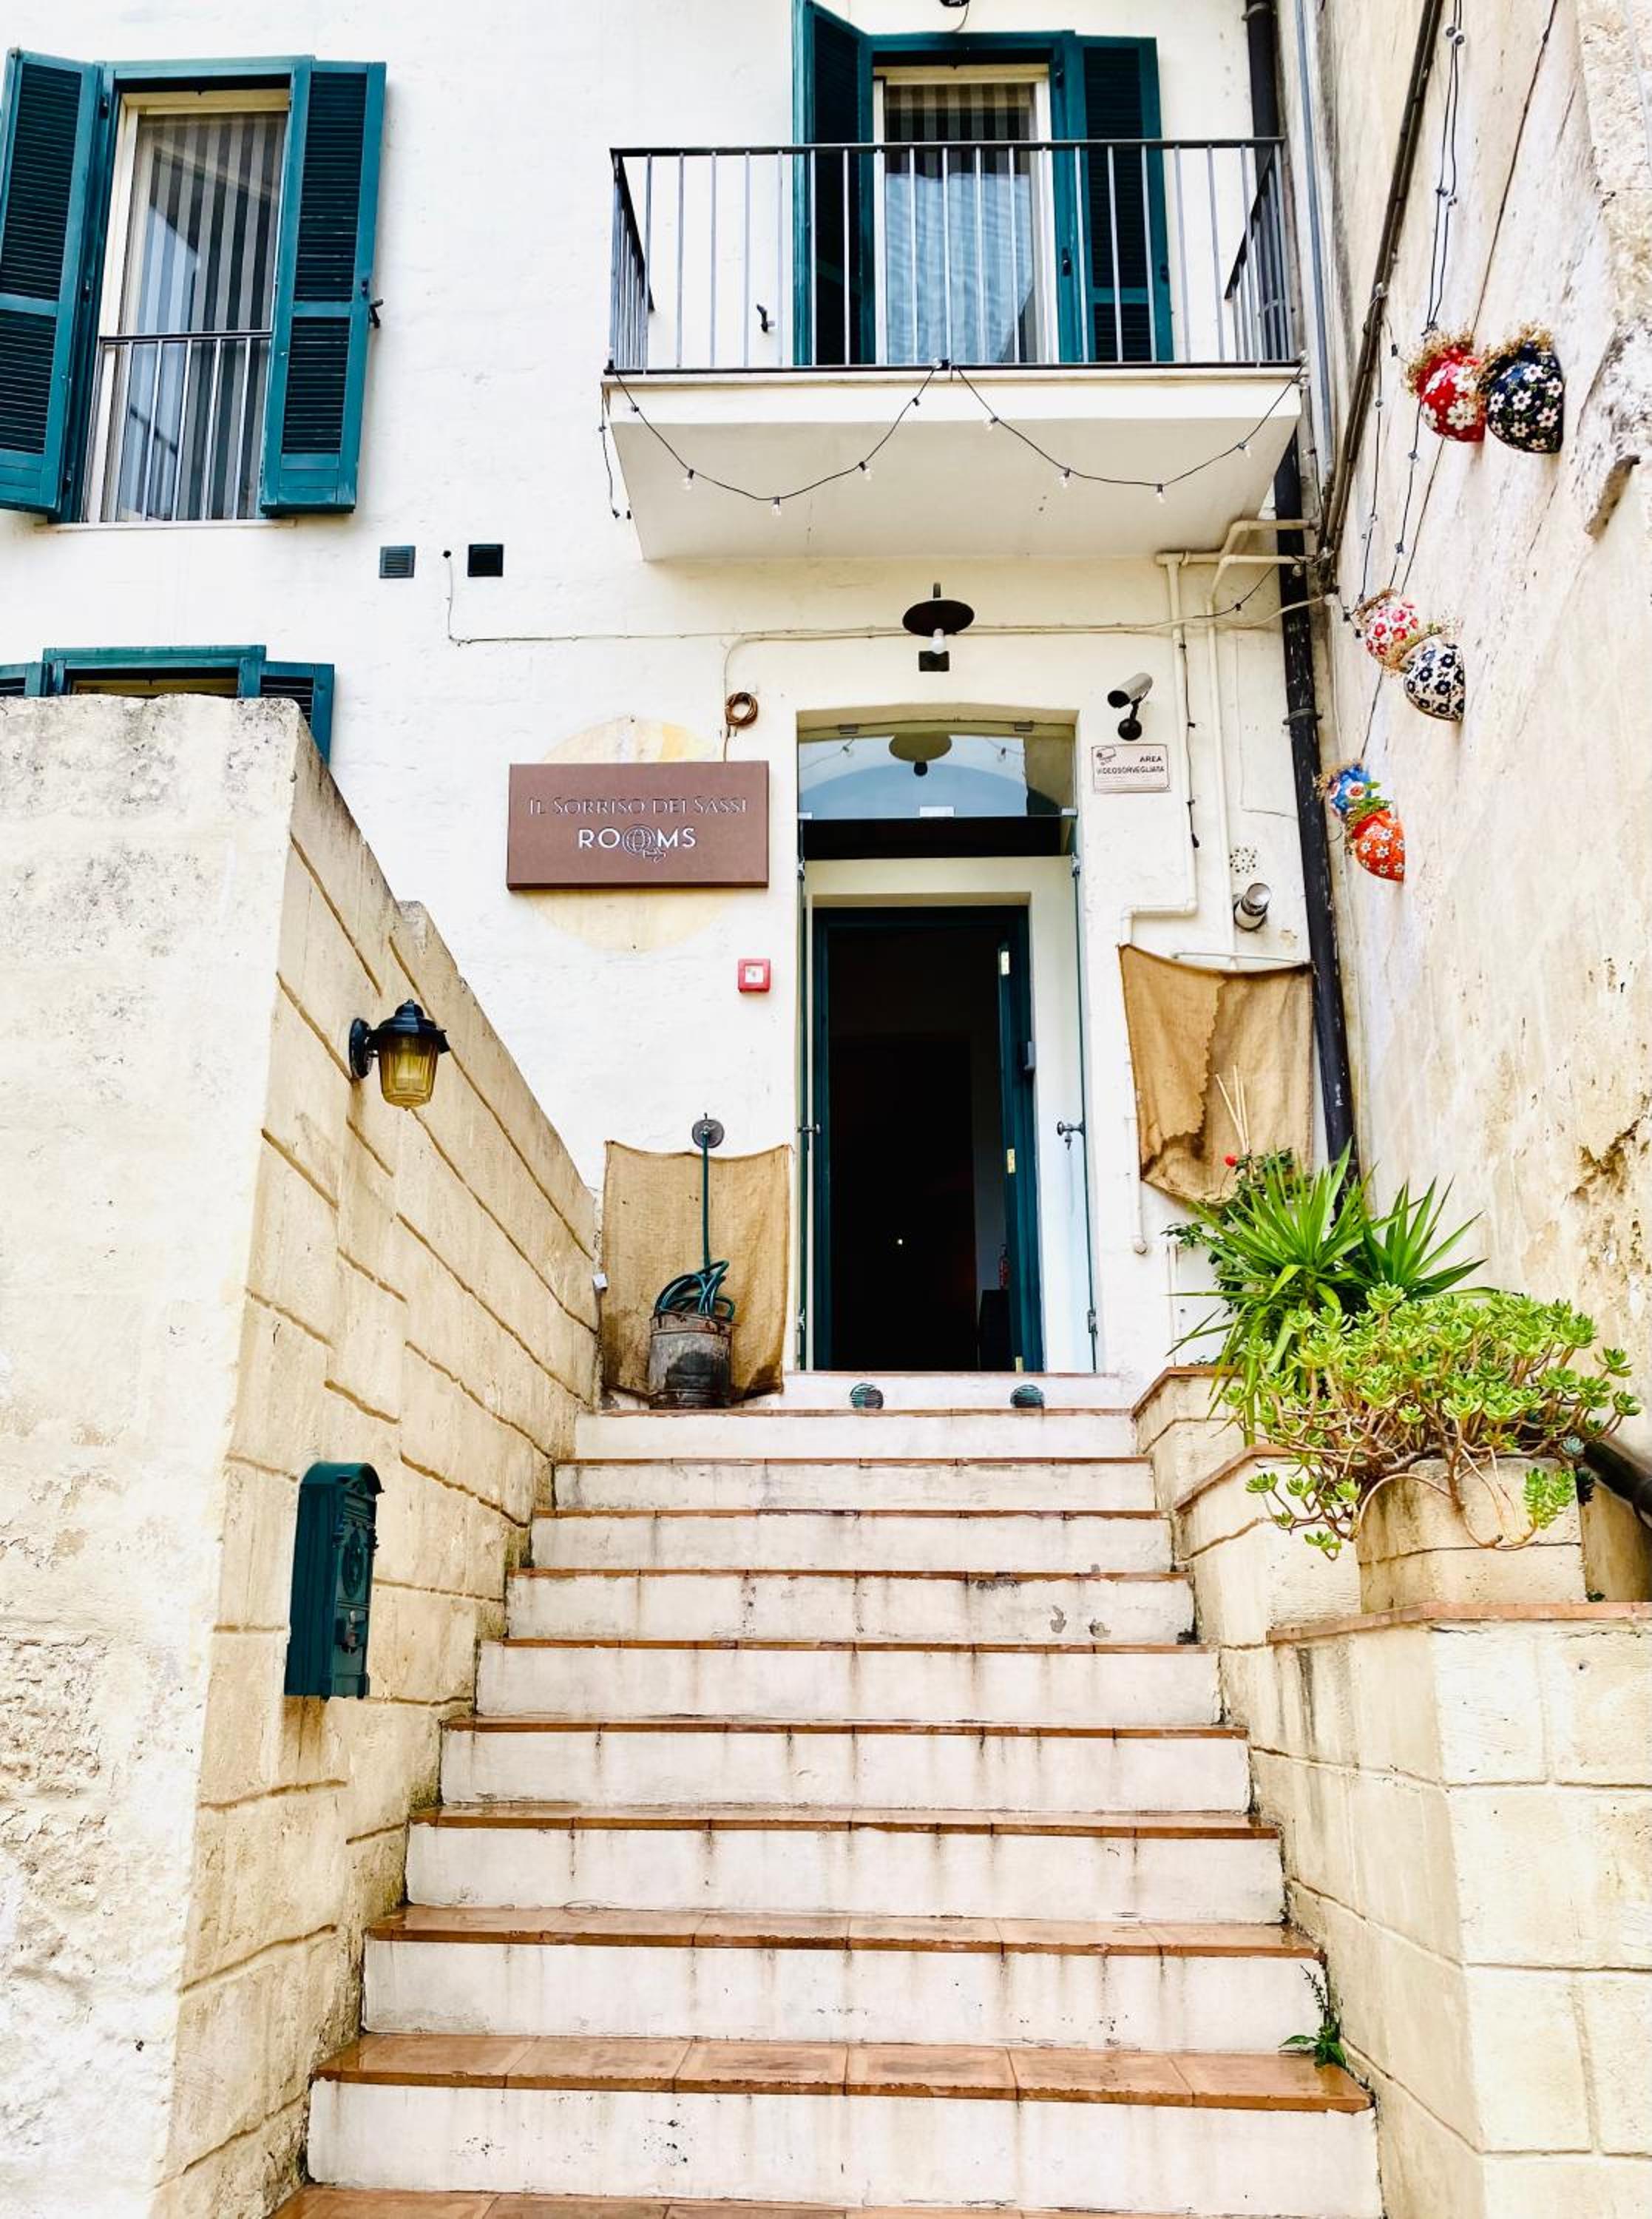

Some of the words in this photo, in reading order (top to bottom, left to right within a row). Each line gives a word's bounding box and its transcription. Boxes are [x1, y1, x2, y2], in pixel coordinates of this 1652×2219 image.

[553, 797, 646, 814] SORRISO
[652, 798, 687, 814] DEI
[693, 795, 747, 814] SASSI
[578, 826, 697, 852] ROOMS
